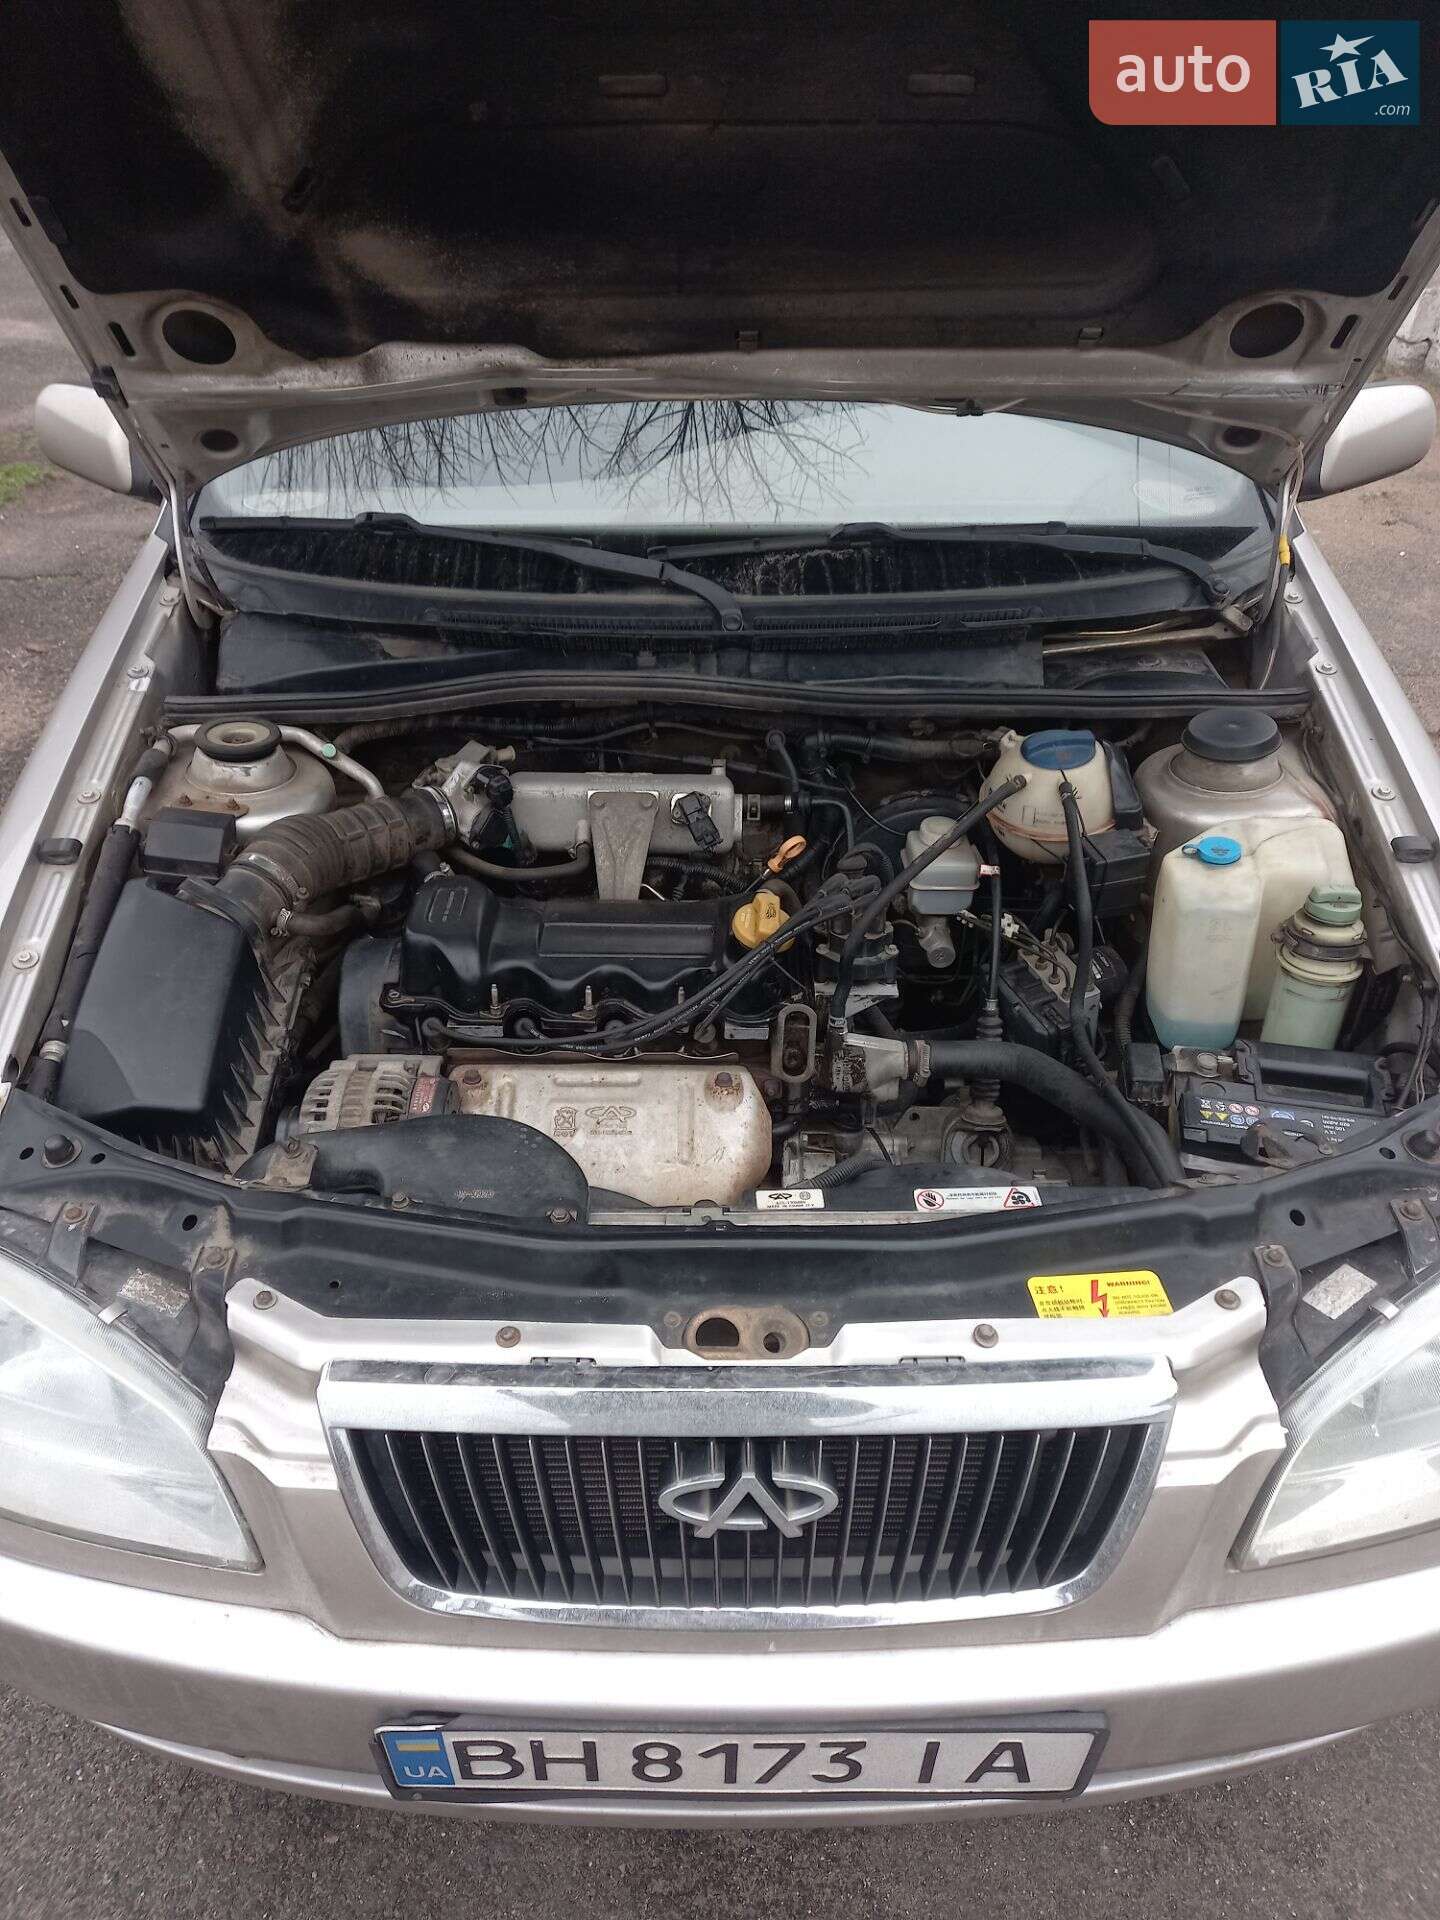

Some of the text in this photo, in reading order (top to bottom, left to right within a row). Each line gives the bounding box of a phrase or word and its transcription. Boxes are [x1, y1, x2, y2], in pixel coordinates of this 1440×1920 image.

[403, 1766, 448, 1778] UA
[452, 1740, 1031, 1784] BH 8173 IA
